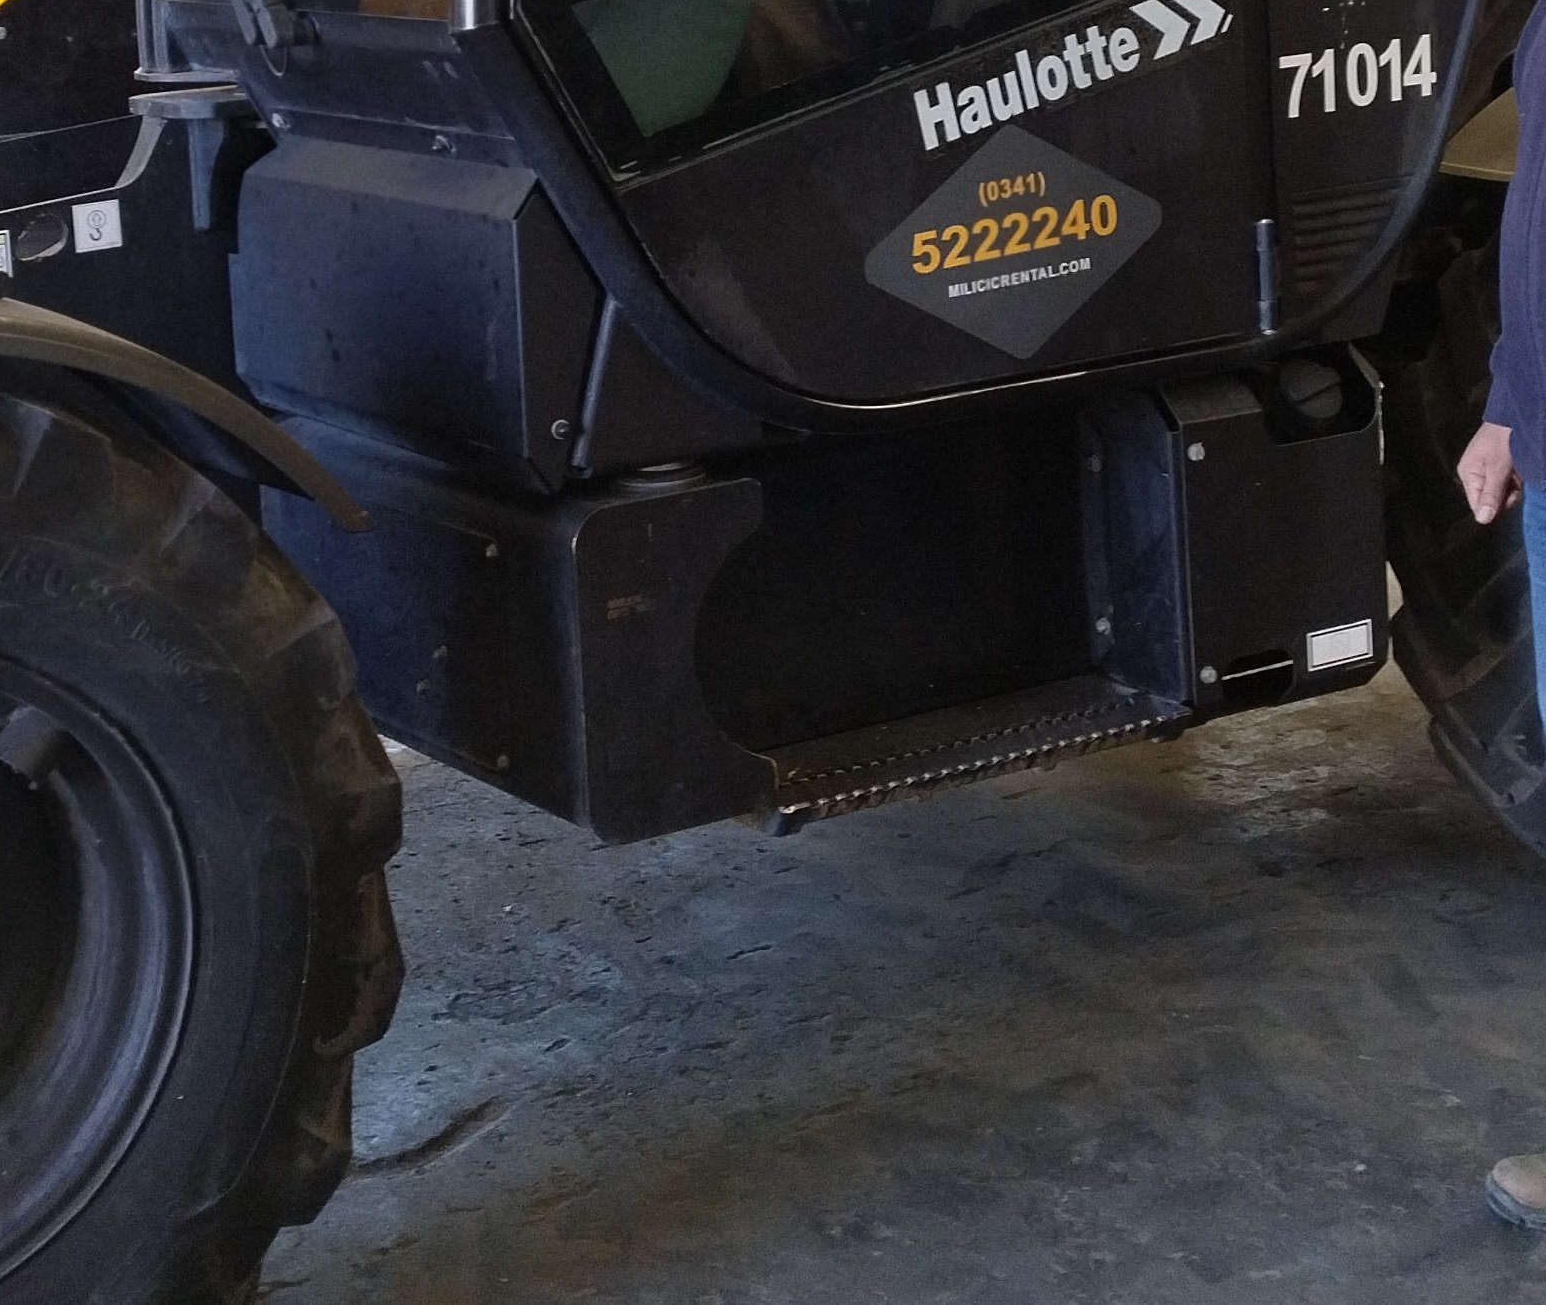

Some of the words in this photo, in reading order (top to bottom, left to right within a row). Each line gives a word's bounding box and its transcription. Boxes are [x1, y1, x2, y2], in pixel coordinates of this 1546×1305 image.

[913, 21, 1142, 151] Haulotte
[1279, 34, 1437, 119] 71014
[977, 172, 1046, 207] (0341)
[912, 195, 1118, 275] 5222240
[949, 258, 1091, 298] MILICICRENTAL.COM
